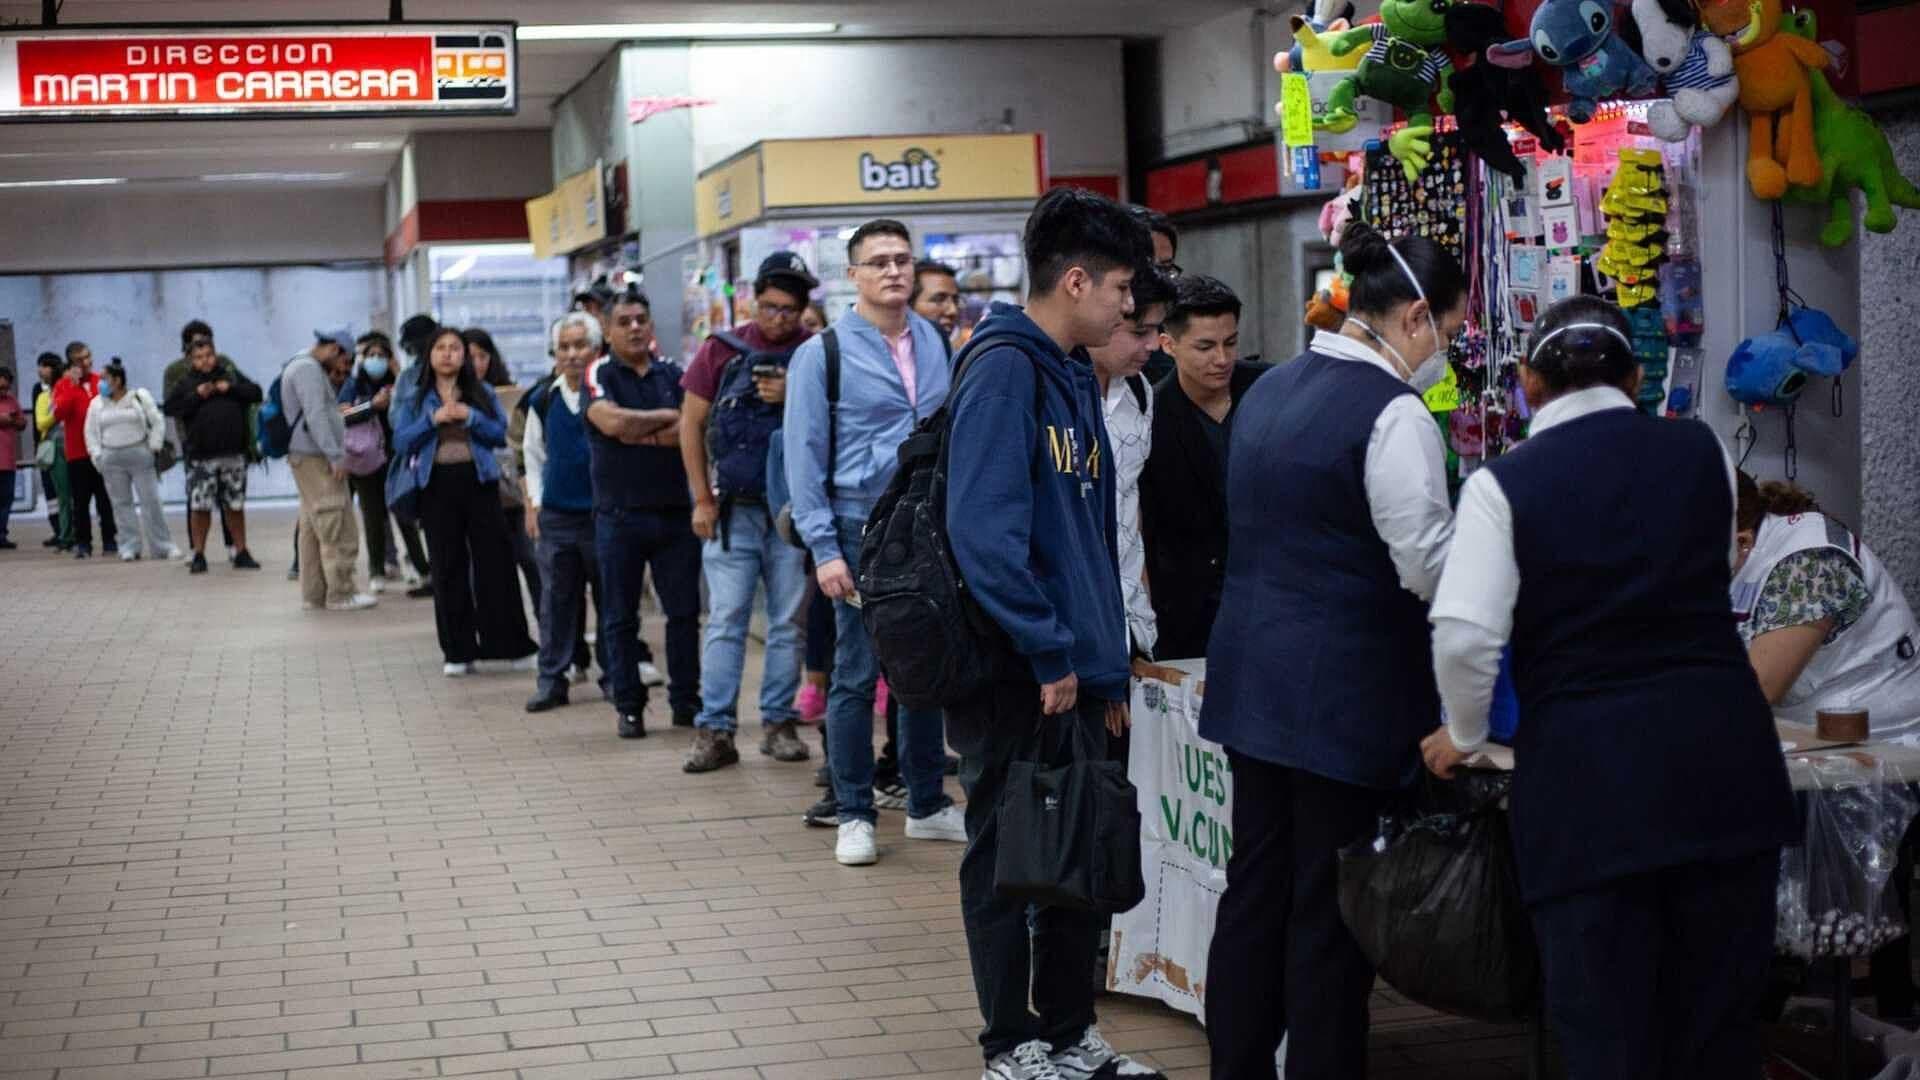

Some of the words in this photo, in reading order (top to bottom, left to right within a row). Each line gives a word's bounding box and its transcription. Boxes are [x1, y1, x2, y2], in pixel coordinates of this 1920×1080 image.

[127, 43, 333, 66] DIRECCION
[33, 73, 197, 103] MARTIN
[215, 68, 418, 100] CARRERA
[861, 149, 939, 190] bait
